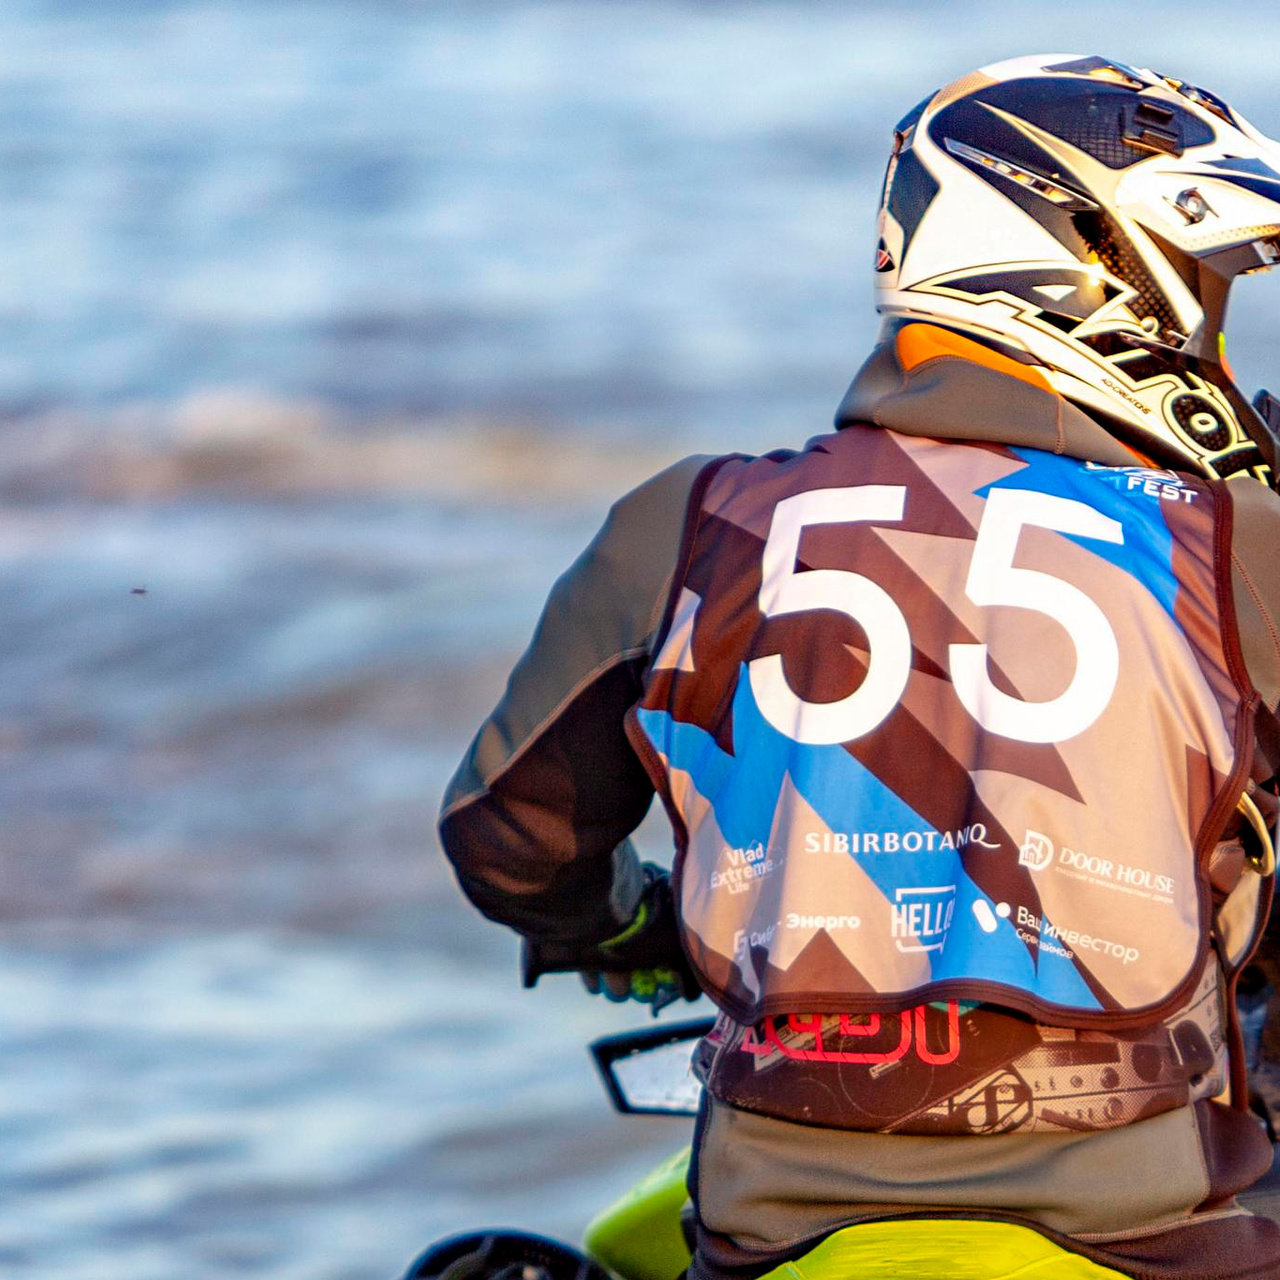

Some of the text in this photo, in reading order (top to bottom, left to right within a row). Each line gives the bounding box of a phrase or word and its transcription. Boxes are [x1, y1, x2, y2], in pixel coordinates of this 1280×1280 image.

[1127, 475, 1199, 503] FEST
[749, 485, 1127, 746] 55
[804, 823, 1001, 854] SIBIRBOTANIQ
[726, 842, 765, 866] Vlad
[1058, 847, 1114, 878] DOOR
[1116, 864, 1175, 895] HOUSE
[785, 912, 861, 931] Энерго
